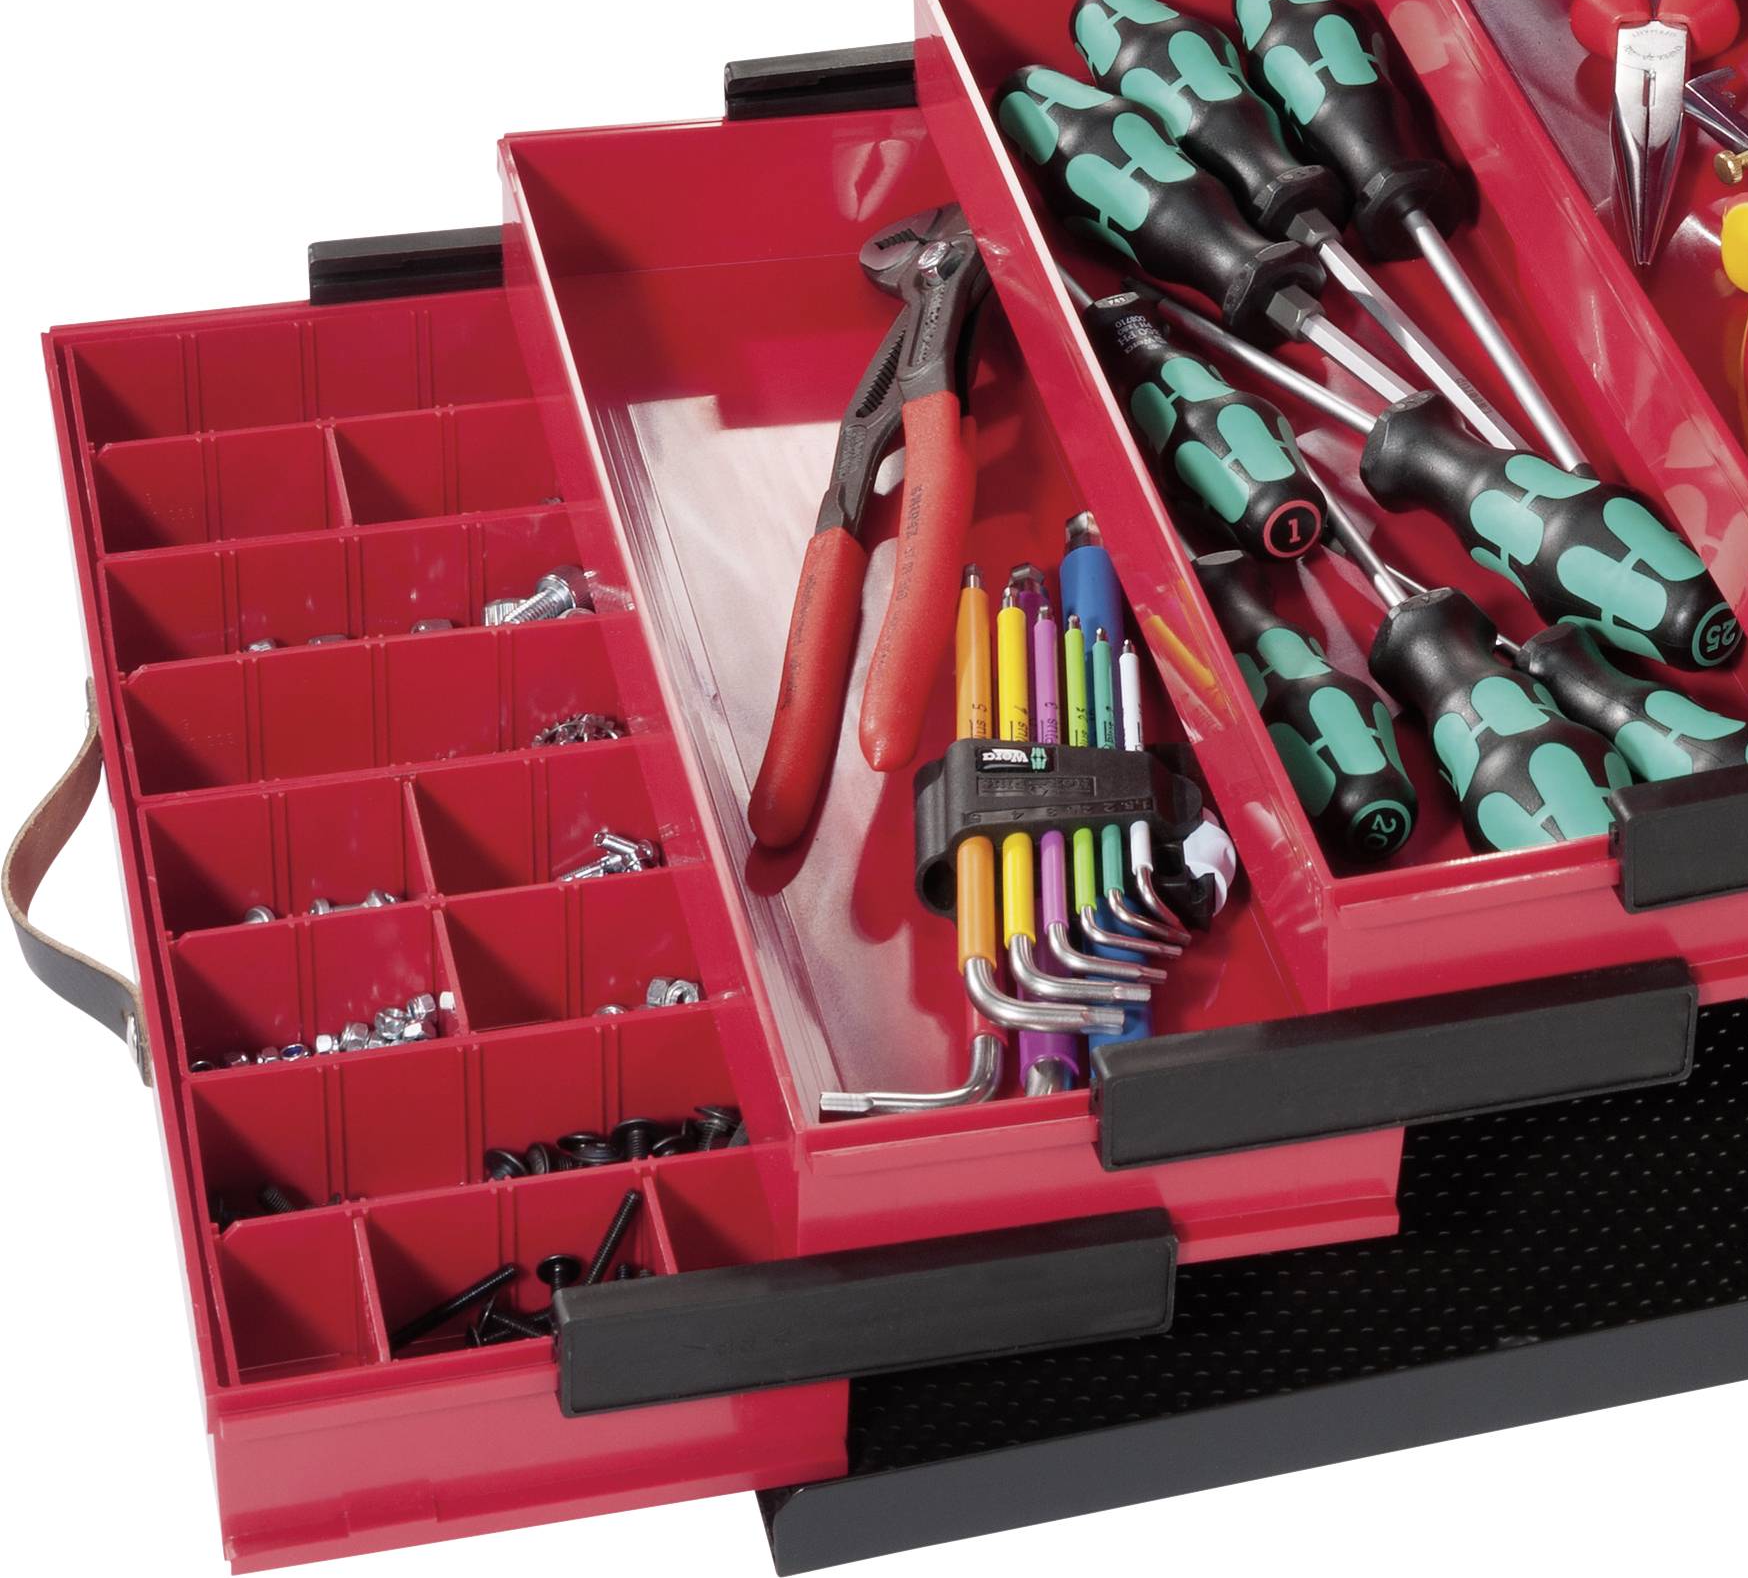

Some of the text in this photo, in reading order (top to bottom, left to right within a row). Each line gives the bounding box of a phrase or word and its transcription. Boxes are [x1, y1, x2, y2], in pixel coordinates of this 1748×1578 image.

[1288, 518, 1301, 544] 1
[1706, 618, 1737, 653] 25
[982, 748, 1030, 764] Wera
[1010, 810, 1025, 821] 4
[1103, 802, 1117, 814] 2
